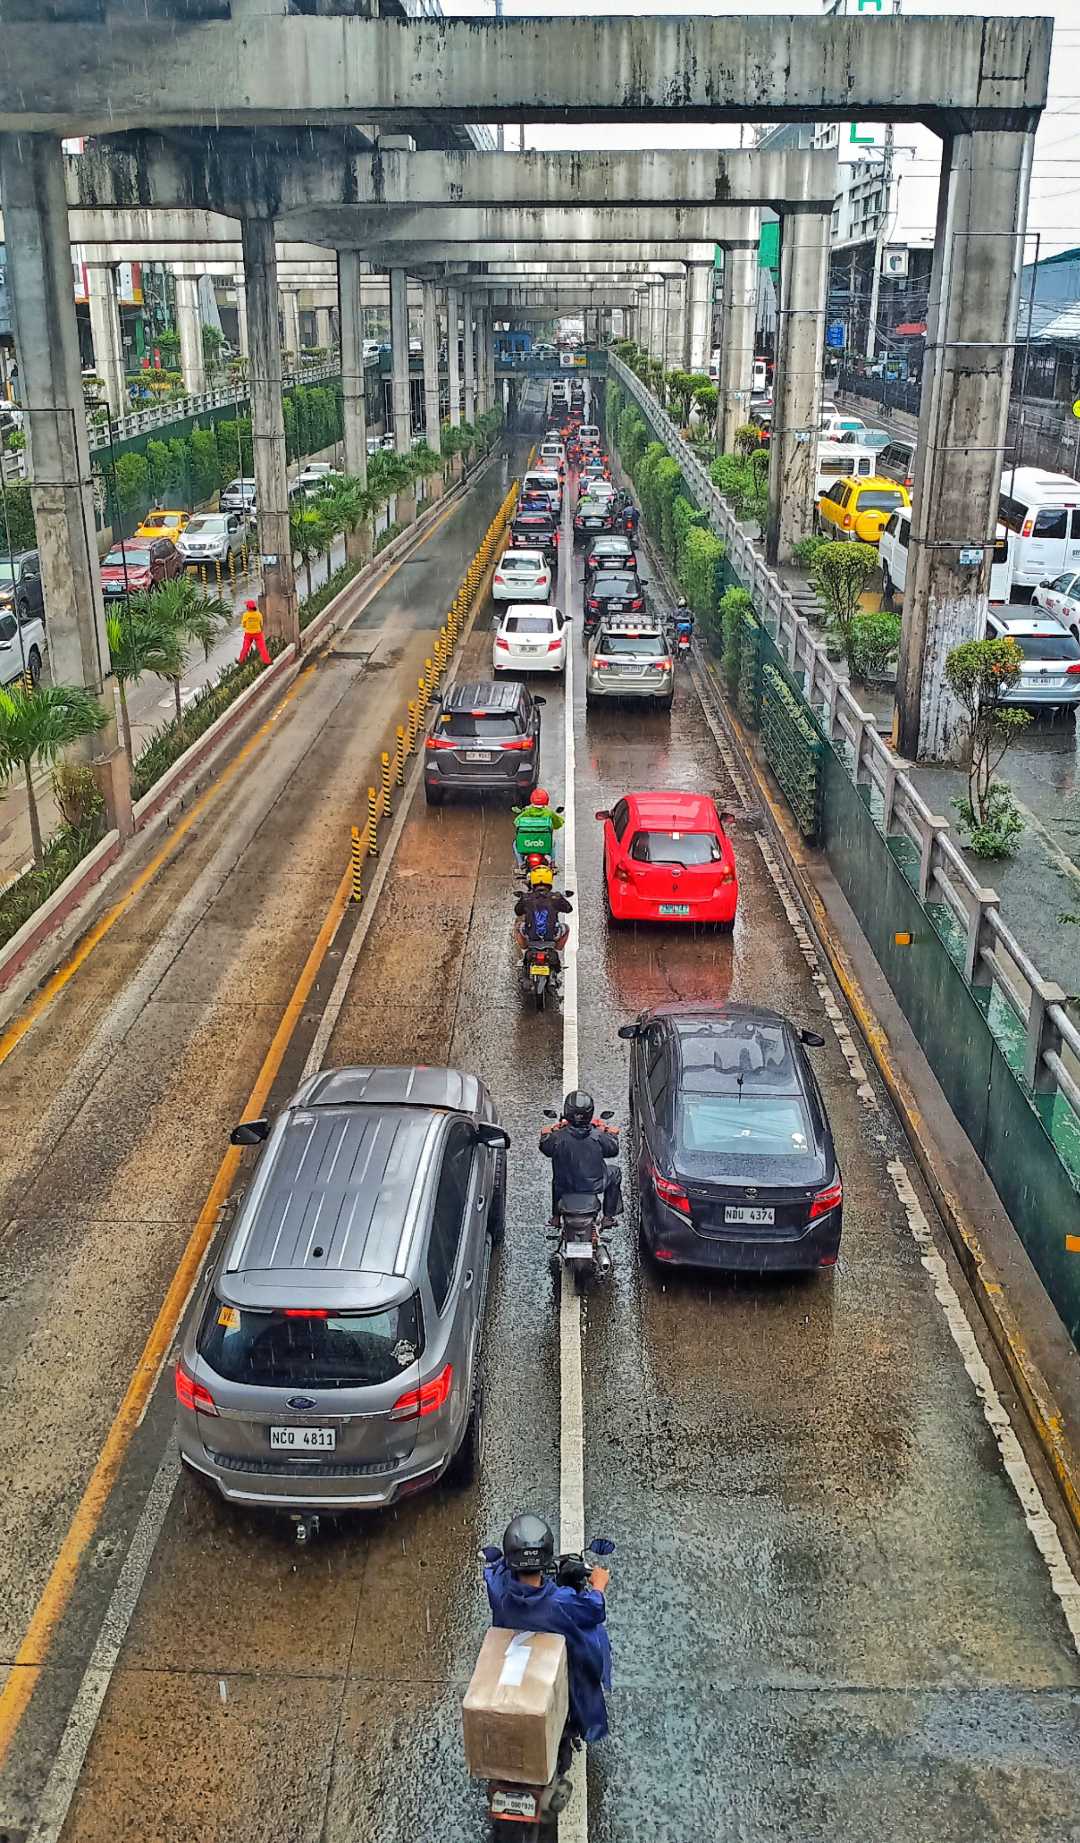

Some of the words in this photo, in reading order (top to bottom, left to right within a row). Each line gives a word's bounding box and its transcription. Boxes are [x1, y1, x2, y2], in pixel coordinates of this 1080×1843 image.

[524, 839, 545, 848] Grab
[750, 1210, 773, 1221] 4374
[272, 1431, 295, 1445] NCQ
[303, 1432, 333, 1446] 4811
